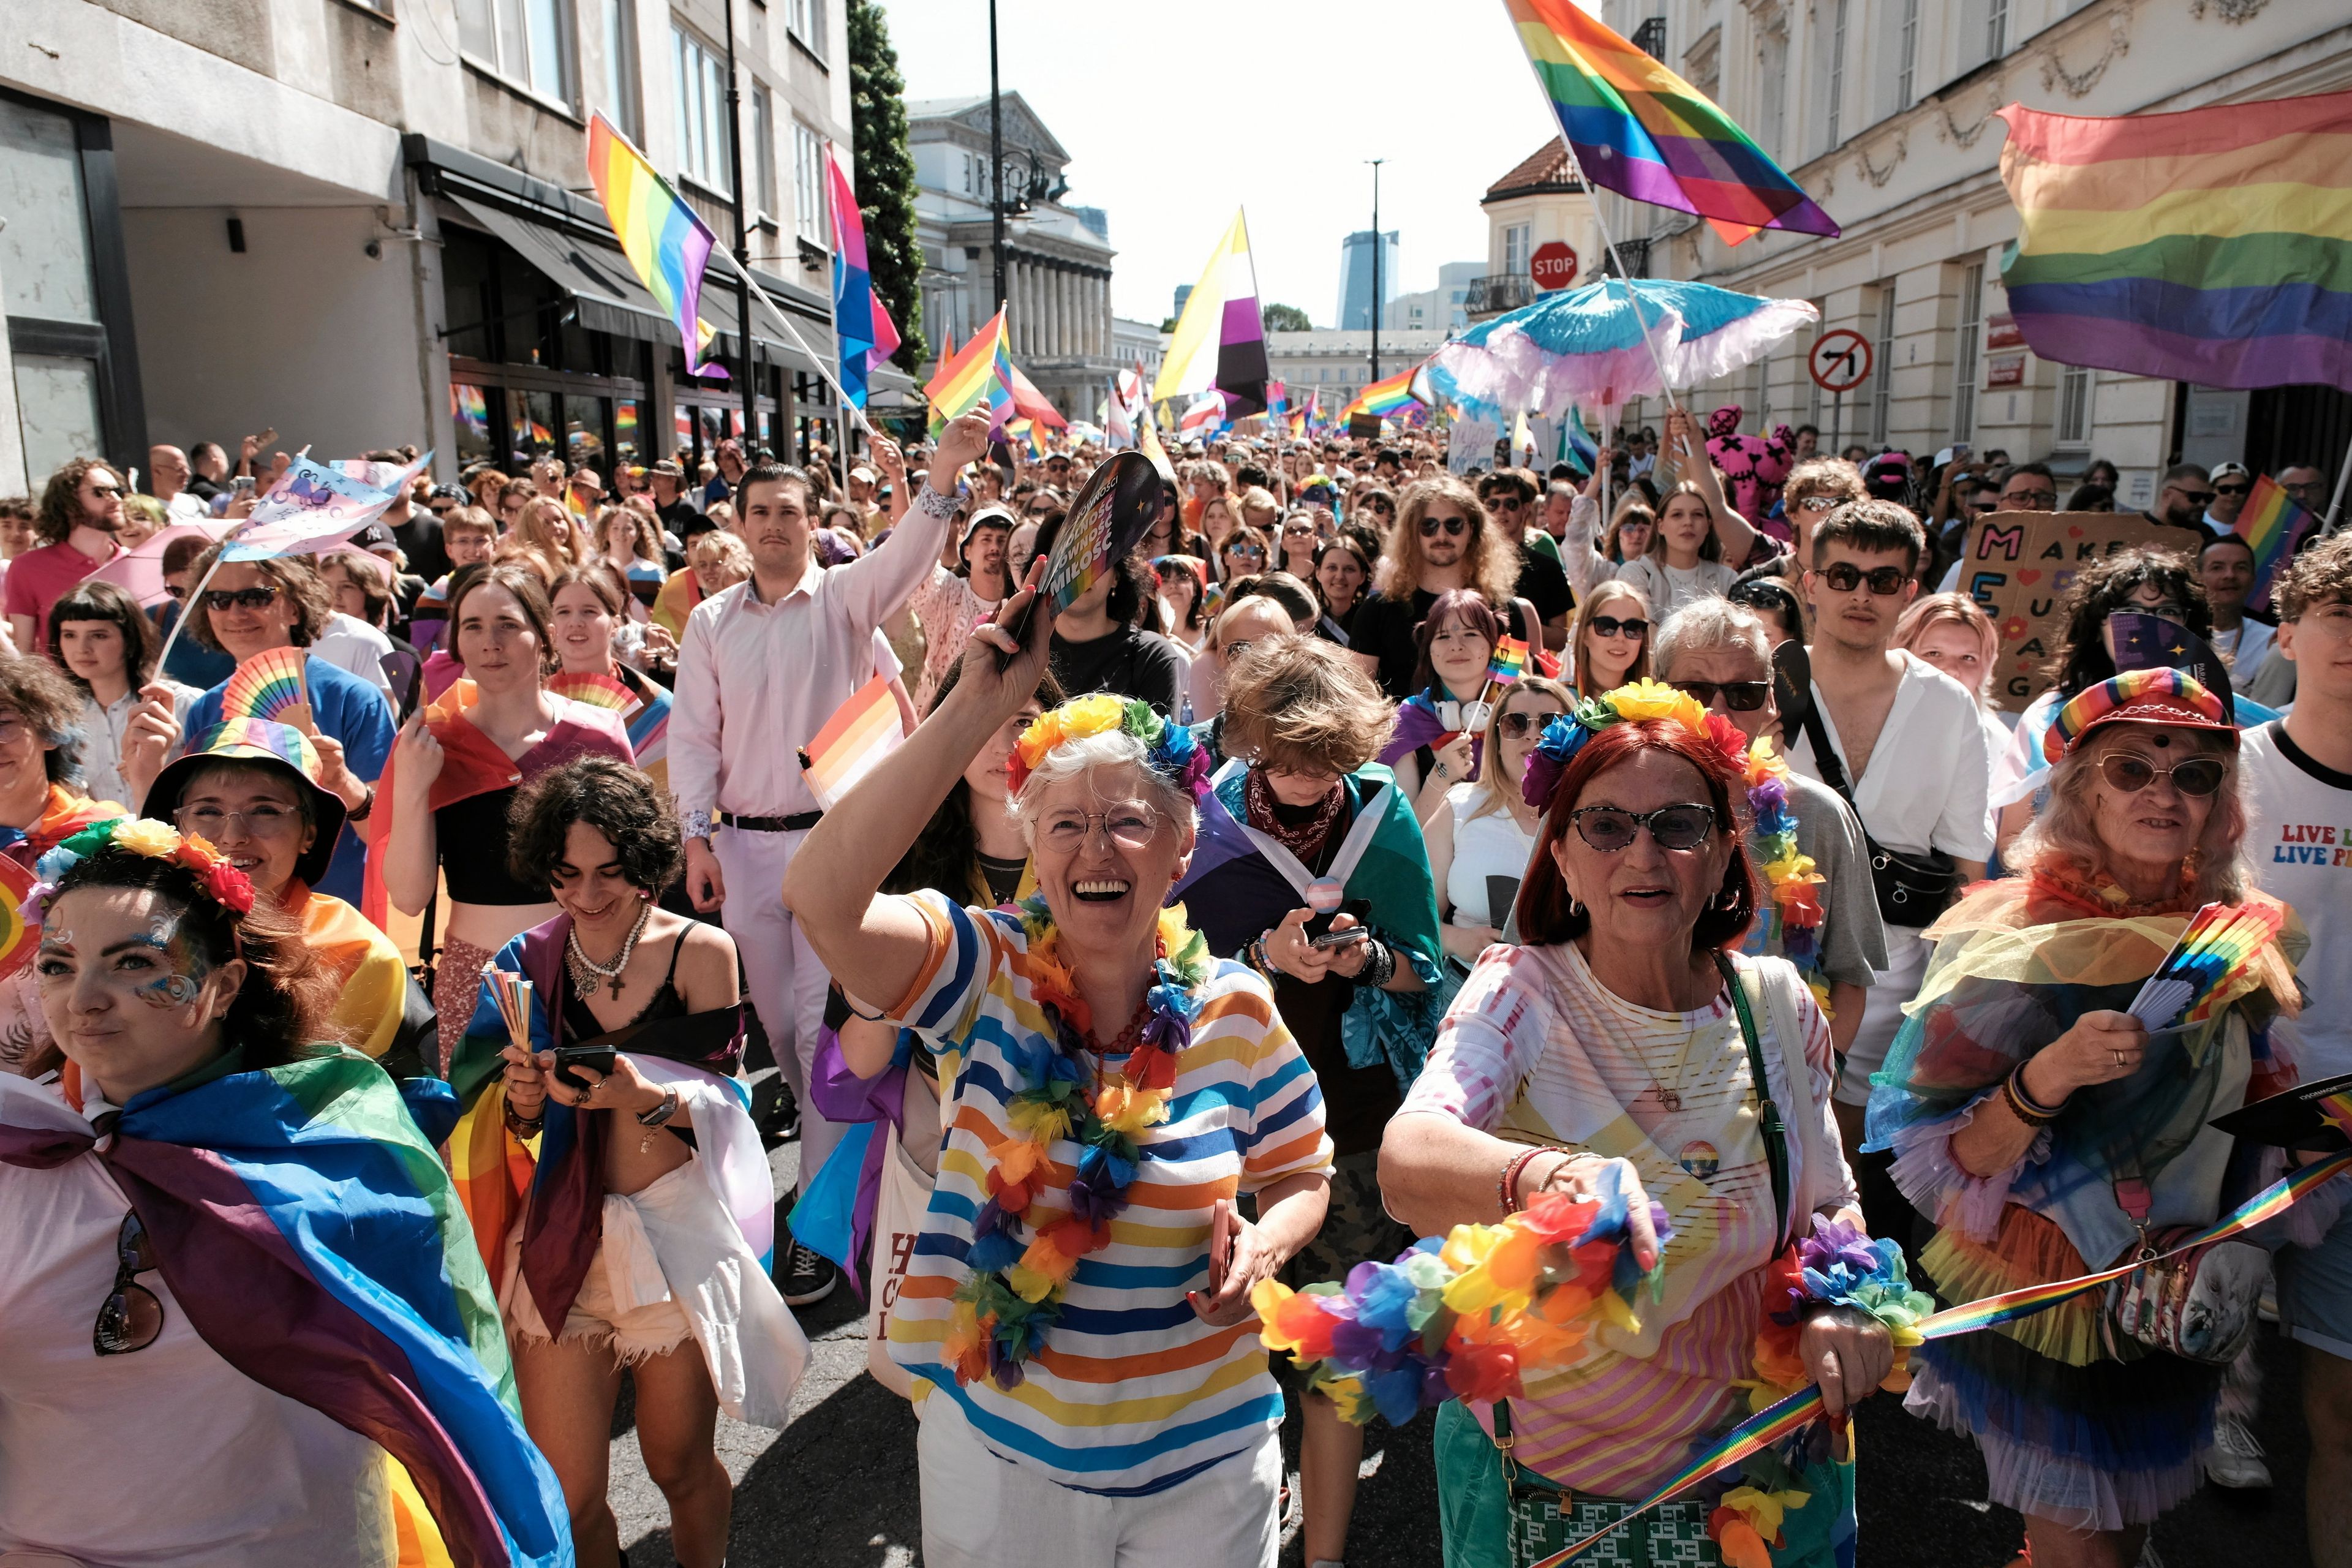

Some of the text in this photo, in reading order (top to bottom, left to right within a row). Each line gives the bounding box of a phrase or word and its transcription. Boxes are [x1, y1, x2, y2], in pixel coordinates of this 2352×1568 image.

[1534, 257, 1574, 276] STOP
[1055, 511, 1112, 573] ÓWNOŚĆ
[1049, 527, 1113, 597] MIŁOŚĆ
[2282, 824, 2335, 845] LIVE
[2273, 845, 2327, 865] LIVE
